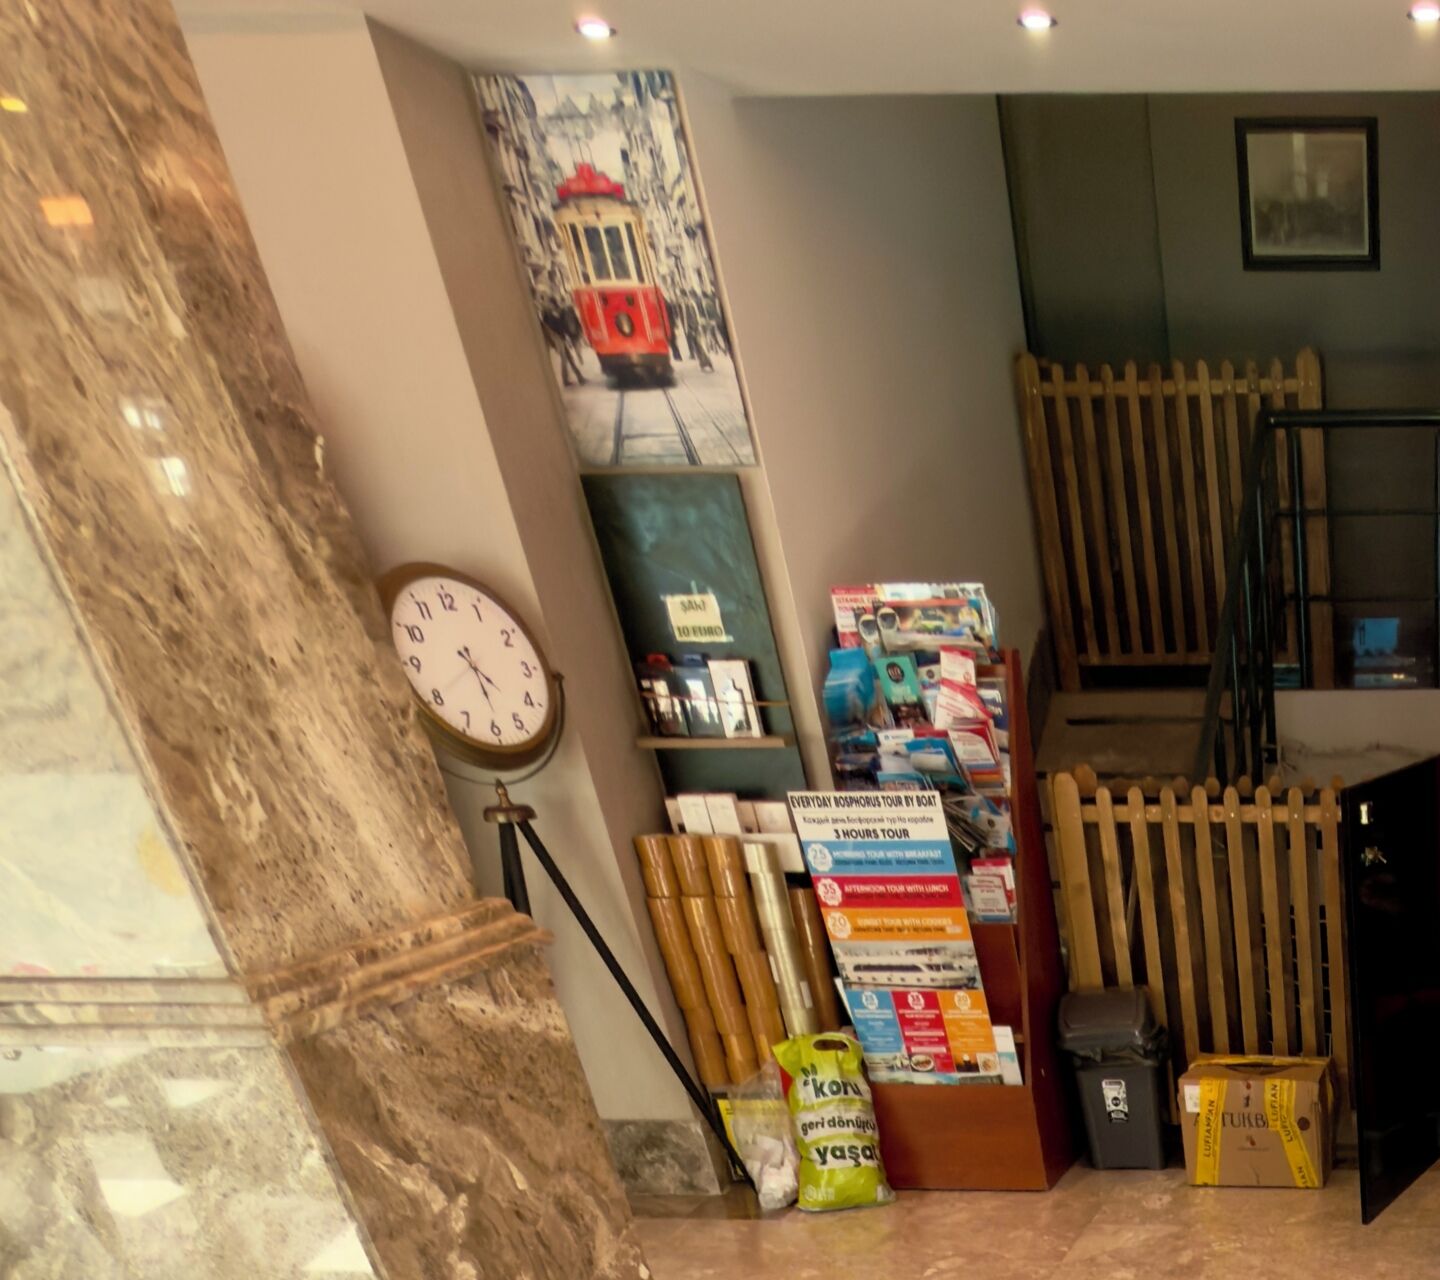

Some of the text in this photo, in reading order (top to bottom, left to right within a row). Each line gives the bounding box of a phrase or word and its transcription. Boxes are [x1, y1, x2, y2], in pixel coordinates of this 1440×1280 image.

[414, 600, 433, 621] 11
[437, 591, 458, 612] 12
[471, 603, 483, 622] 1
[404, 624, 425, 643] 10
[500, 629, 514, 648] 2
[676, 625, 724, 638] 10 EURO
[409, 655, 422, 674] 9
[520, 661, 533, 679] 3
[431, 688, 444, 706] 8
[523, 690, 536, 708] 4
[460, 710, 471, 729] 7
[490, 719, 502, 737] 6
[512, 712, 524, 731] 5
[789, 795, 937, 809] EVERYDAY BOSPHORUS TOUR BY BOAT
[833, 828, 910, 839] 3 HOURS TOUR
[844, 884, 949, 894] AFTERNOON TOUR WITH LUNCH
[810, 1077, 864, 1099] koru
[801, 1116, 825, 1136] geri
